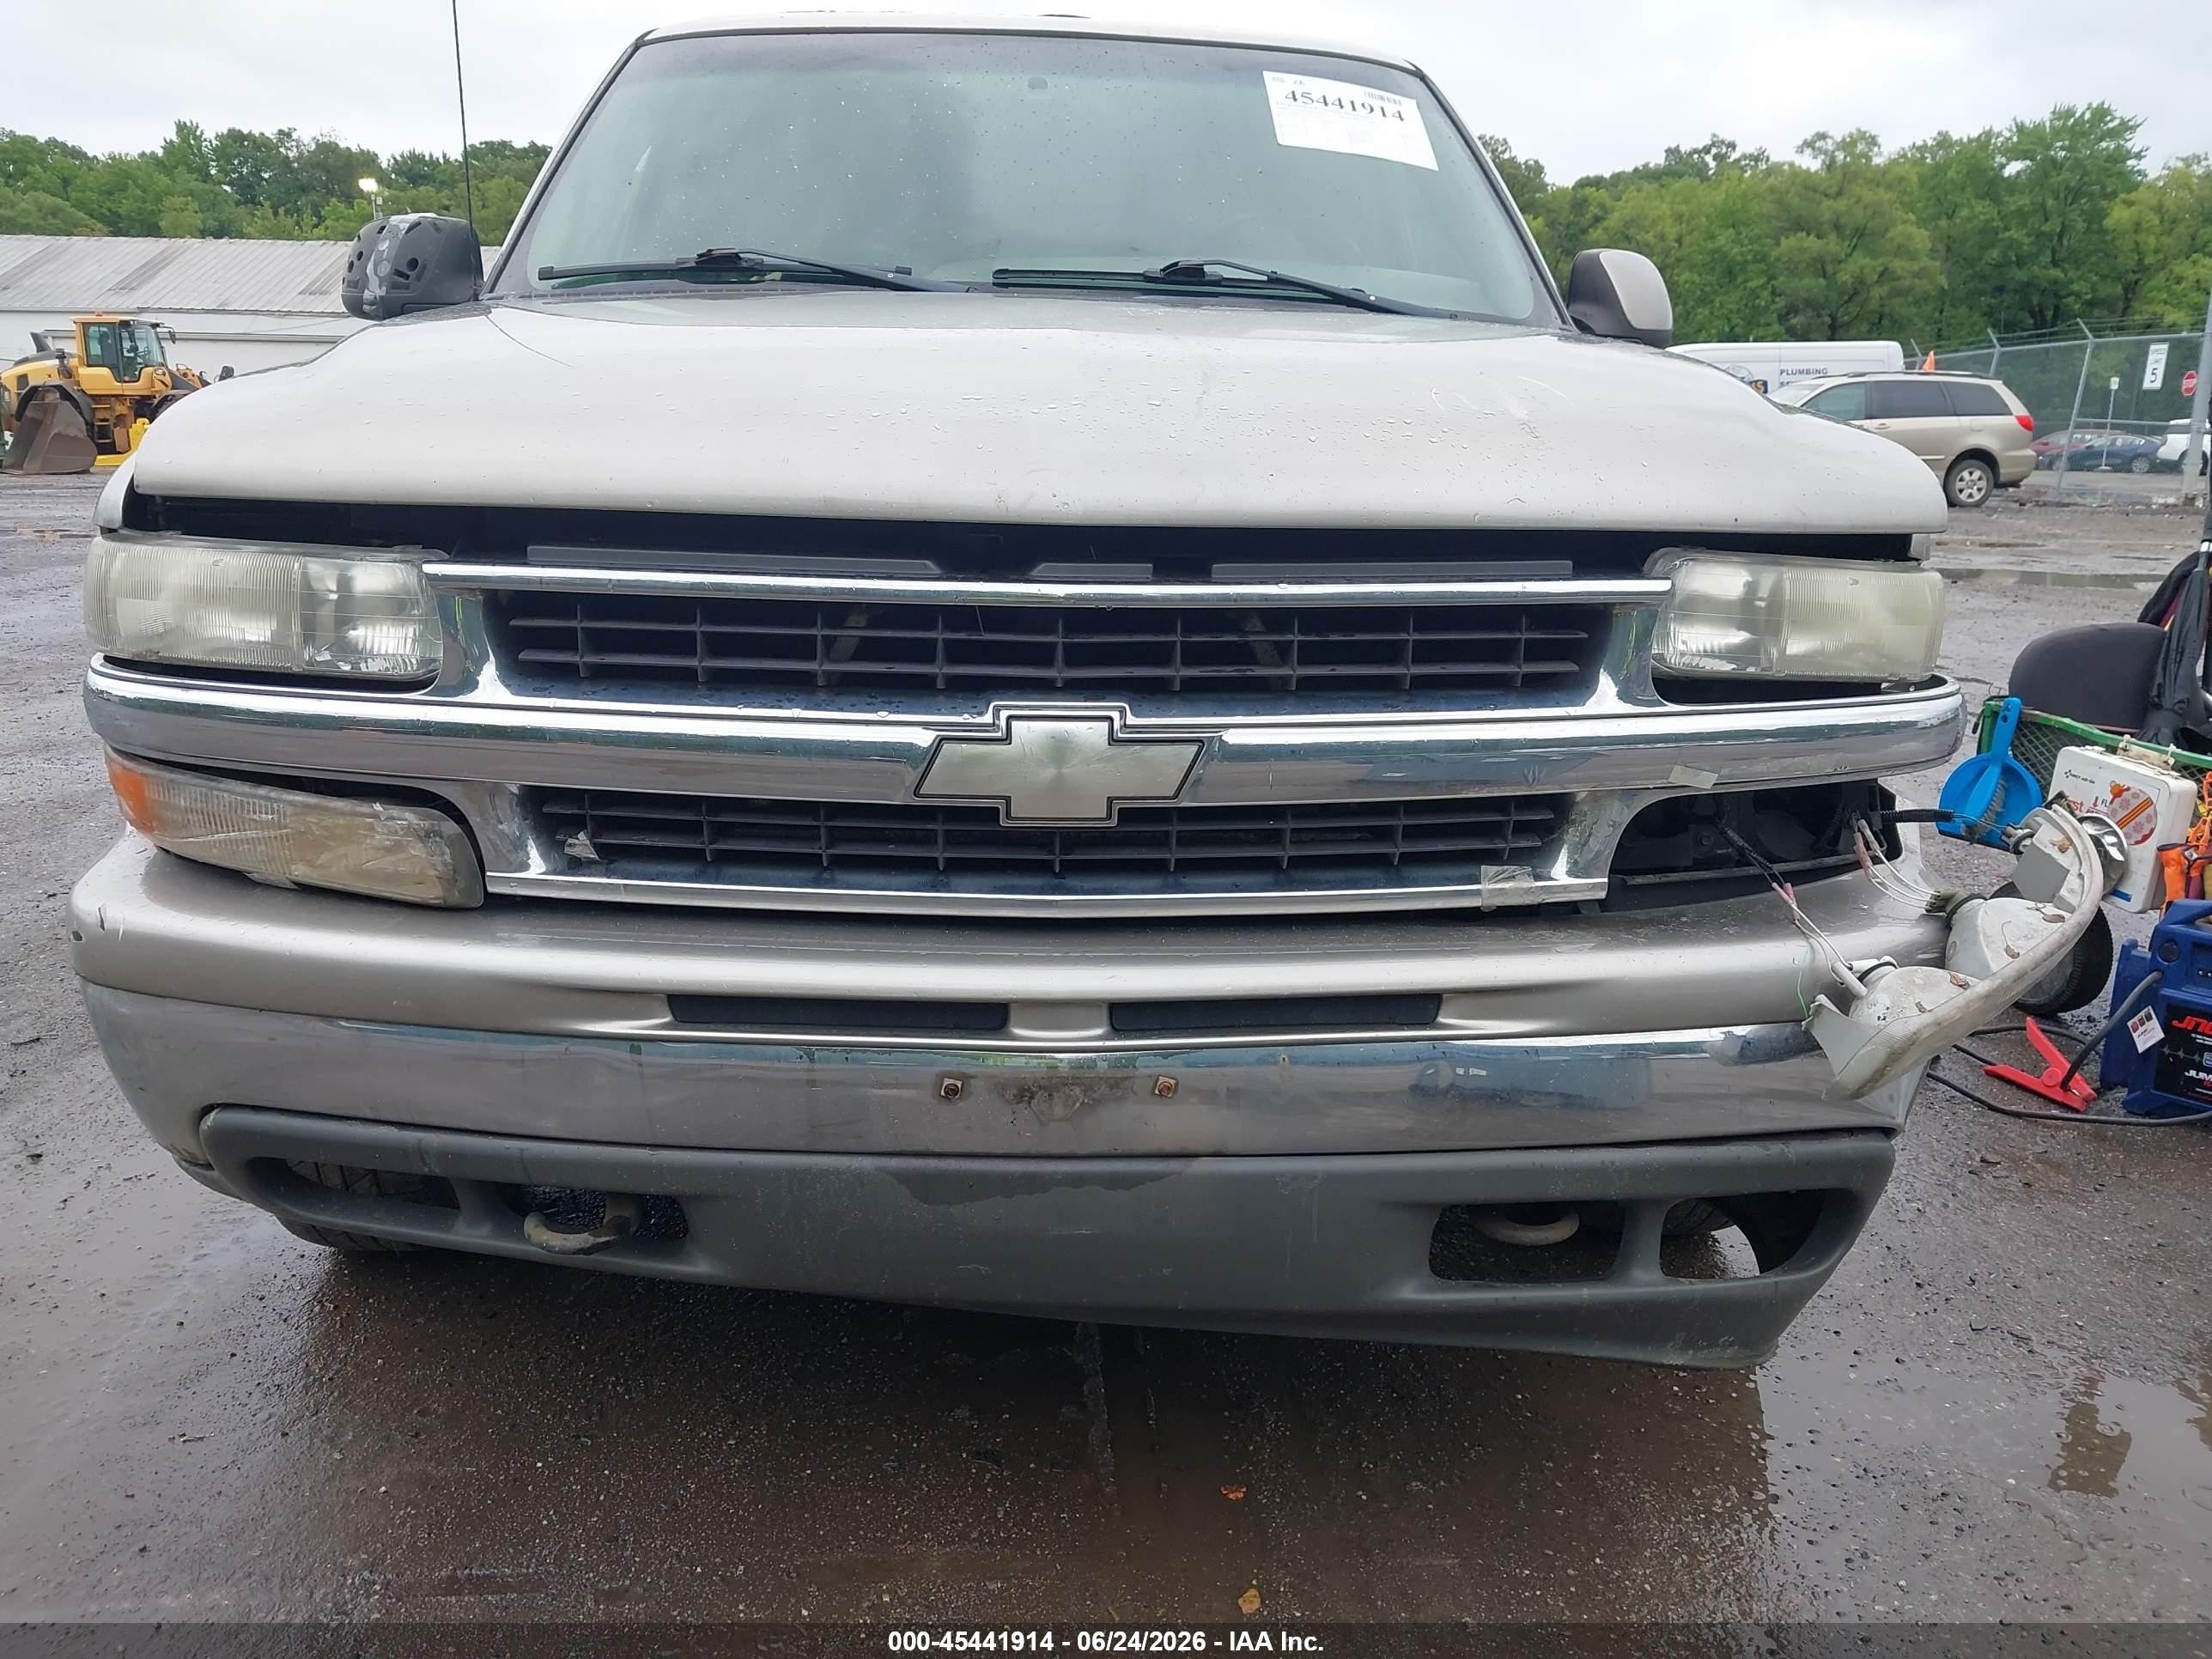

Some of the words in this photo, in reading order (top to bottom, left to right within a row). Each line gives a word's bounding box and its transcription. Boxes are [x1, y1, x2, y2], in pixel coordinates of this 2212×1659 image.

[1285, 89, 1405, 122] 45441914
[1779, 368, 1828, 376] PLUMBING
[2149, 368, 2158, 384] 5
